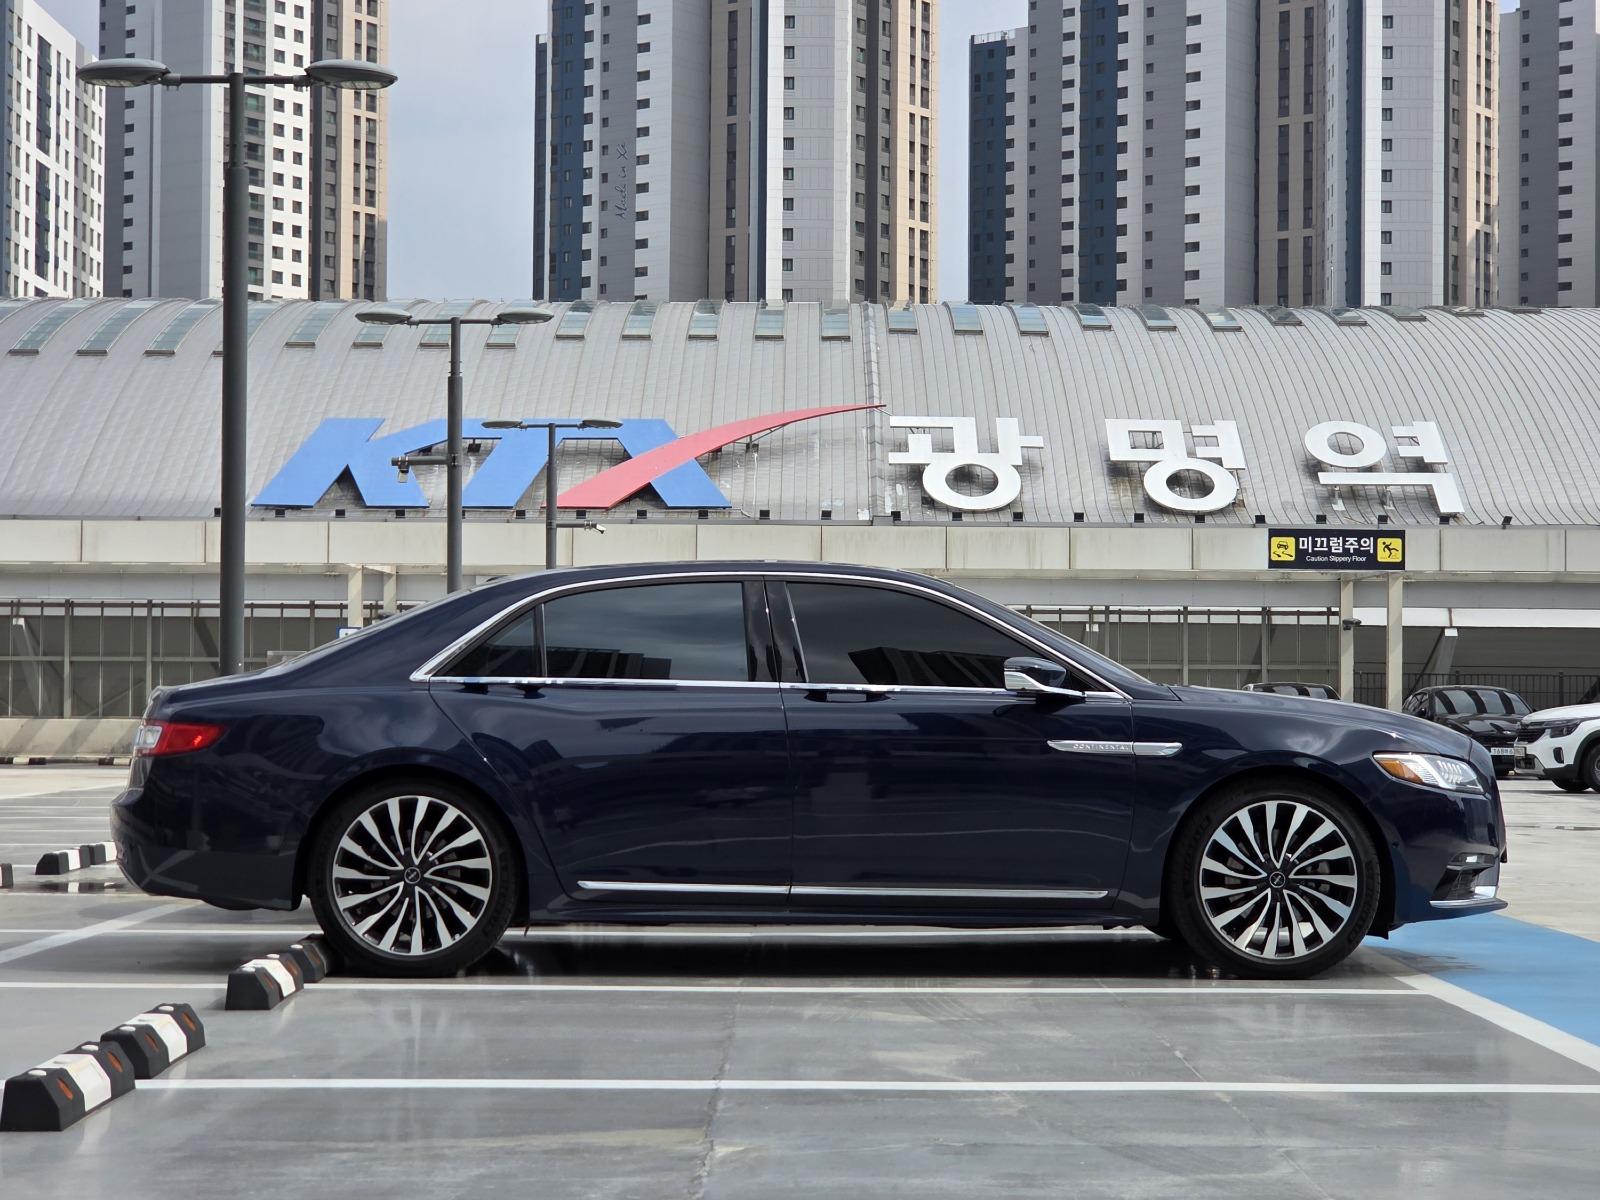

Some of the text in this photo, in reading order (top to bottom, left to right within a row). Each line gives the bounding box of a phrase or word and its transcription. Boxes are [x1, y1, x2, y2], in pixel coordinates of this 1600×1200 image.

[251, 405, 887, 508] KTX
[888, 415, 1465, 515] 광명역
[1299, 536, 1374, 553] 미끄럼주의
[1329, 555, 1351, 563] Slippery
